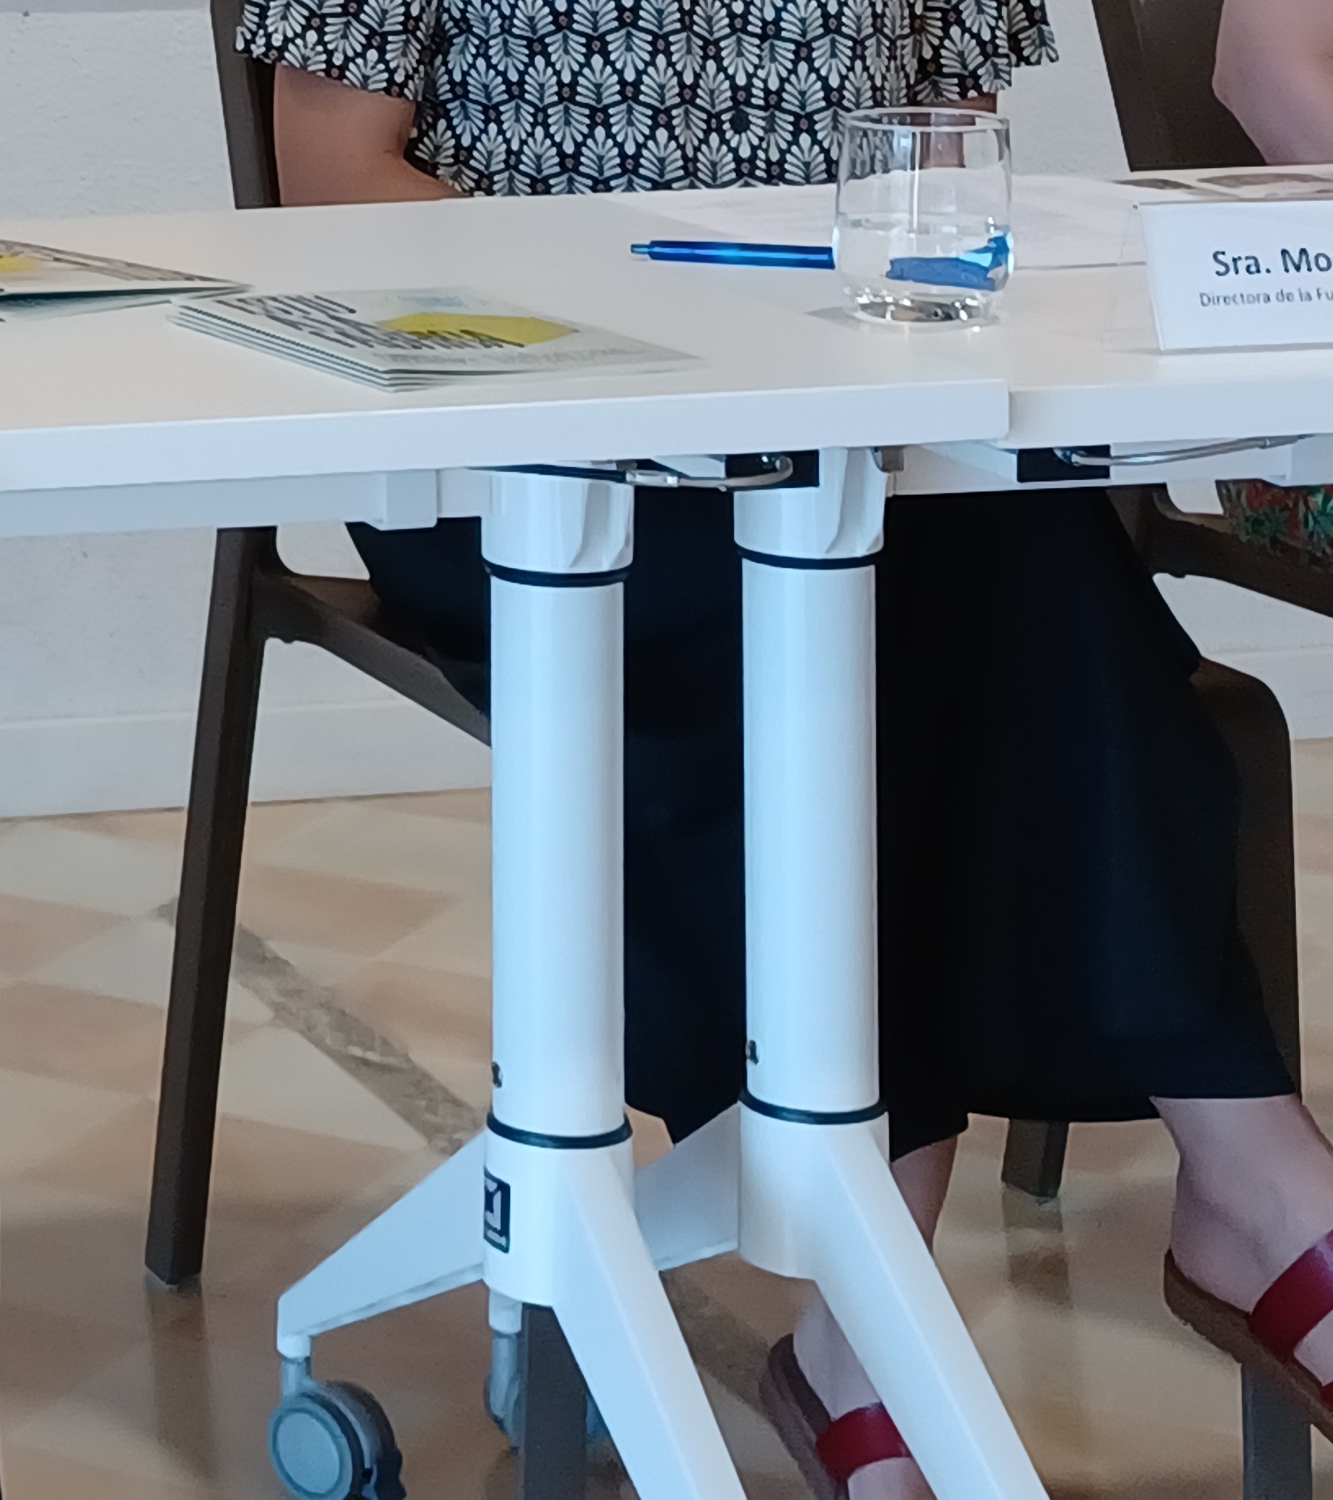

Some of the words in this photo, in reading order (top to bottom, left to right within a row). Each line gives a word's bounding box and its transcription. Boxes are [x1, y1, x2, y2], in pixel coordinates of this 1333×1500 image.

[1212, 250, 1272, 277] Sra.
[1199, 290, 1272, 307] Directora
[1276, 288, 1294, 303] de
[1297, 287, 1313, 302] la
